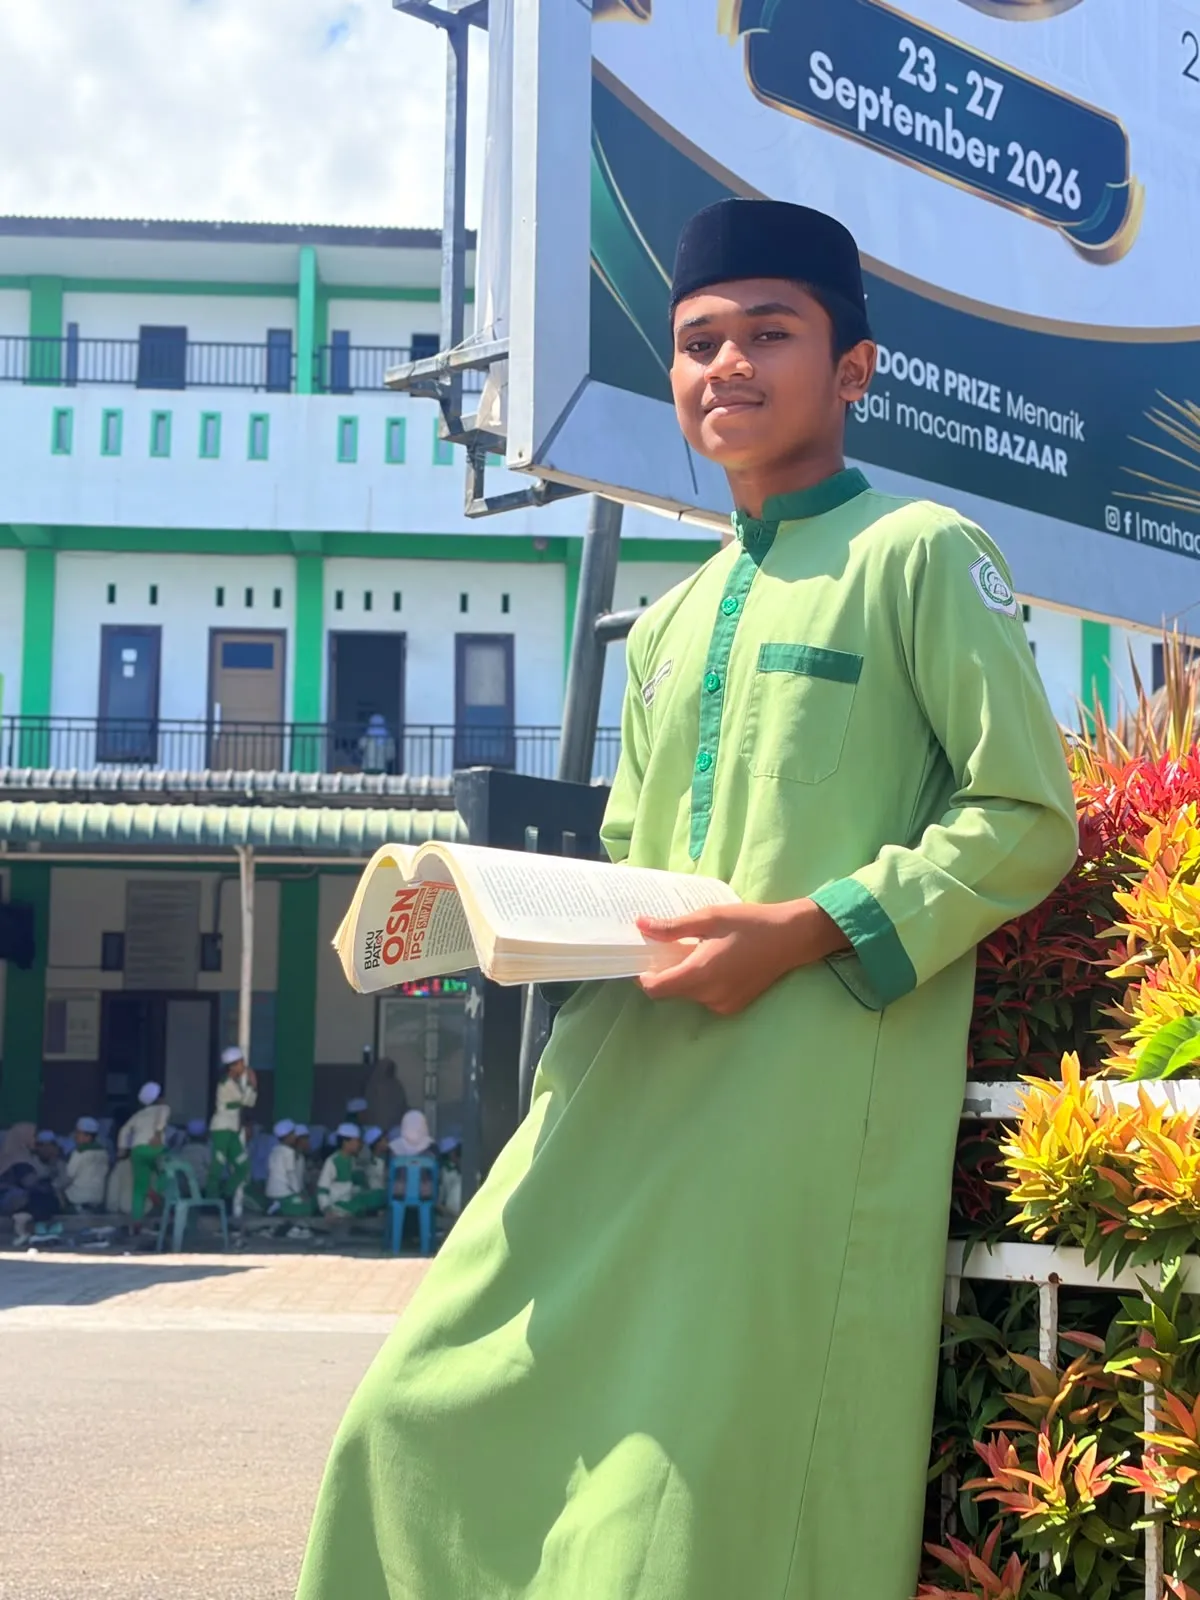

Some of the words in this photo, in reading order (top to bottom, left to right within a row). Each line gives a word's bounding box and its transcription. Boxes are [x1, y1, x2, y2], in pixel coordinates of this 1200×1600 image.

[898, 36, 937, 93] 23
[945, 82, 958, 95] -
[965, 69, 1004, 121] 27
[808, 50, 1000, 174] September
[1006, 141, 1082, 210] 2026
[876, 343, 940, 393] DOOR
[944, 368, 1001, 414] PRIZE
[1006, 390, 1085, 442] Menarik
[984, 424, 1068, 478] BAZAAR
[382, 888, 420, 966] OSN
[416, 887, 439, 929] SMP/MTS
[364, 931, 375, 970] BUKU
[410, 931, 425, 960] IPS
